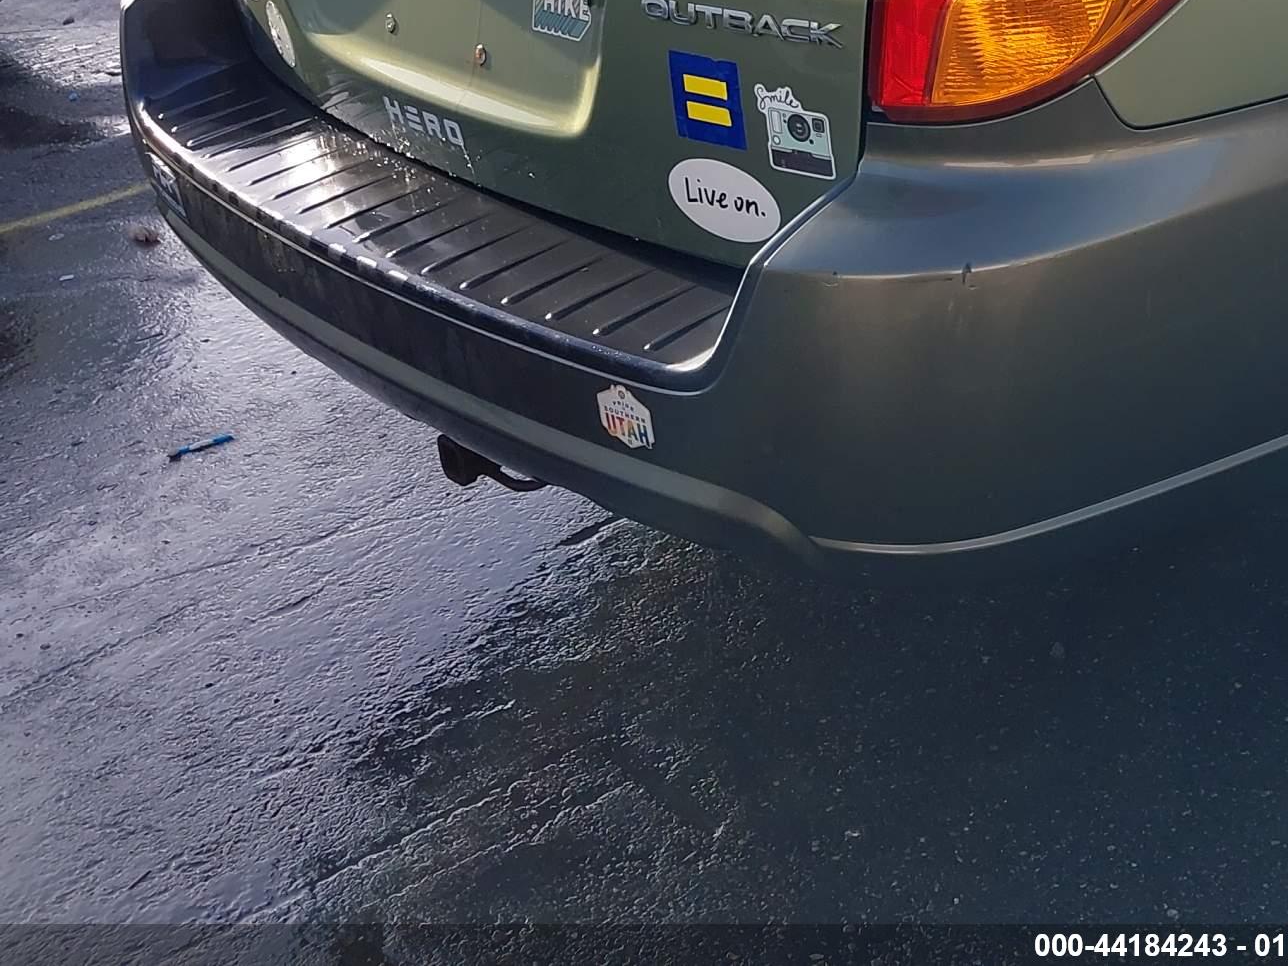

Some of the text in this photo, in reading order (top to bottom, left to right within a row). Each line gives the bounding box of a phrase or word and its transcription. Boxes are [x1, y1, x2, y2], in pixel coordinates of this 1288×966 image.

[756, 86, 800, 110] Smile
[382, 95, 465, 147] HERO
[684, 176, 767, 218] Live on.
[603, 405, 647, 424] SOUTHERN
[605, 412, 651, 447] UTAH
